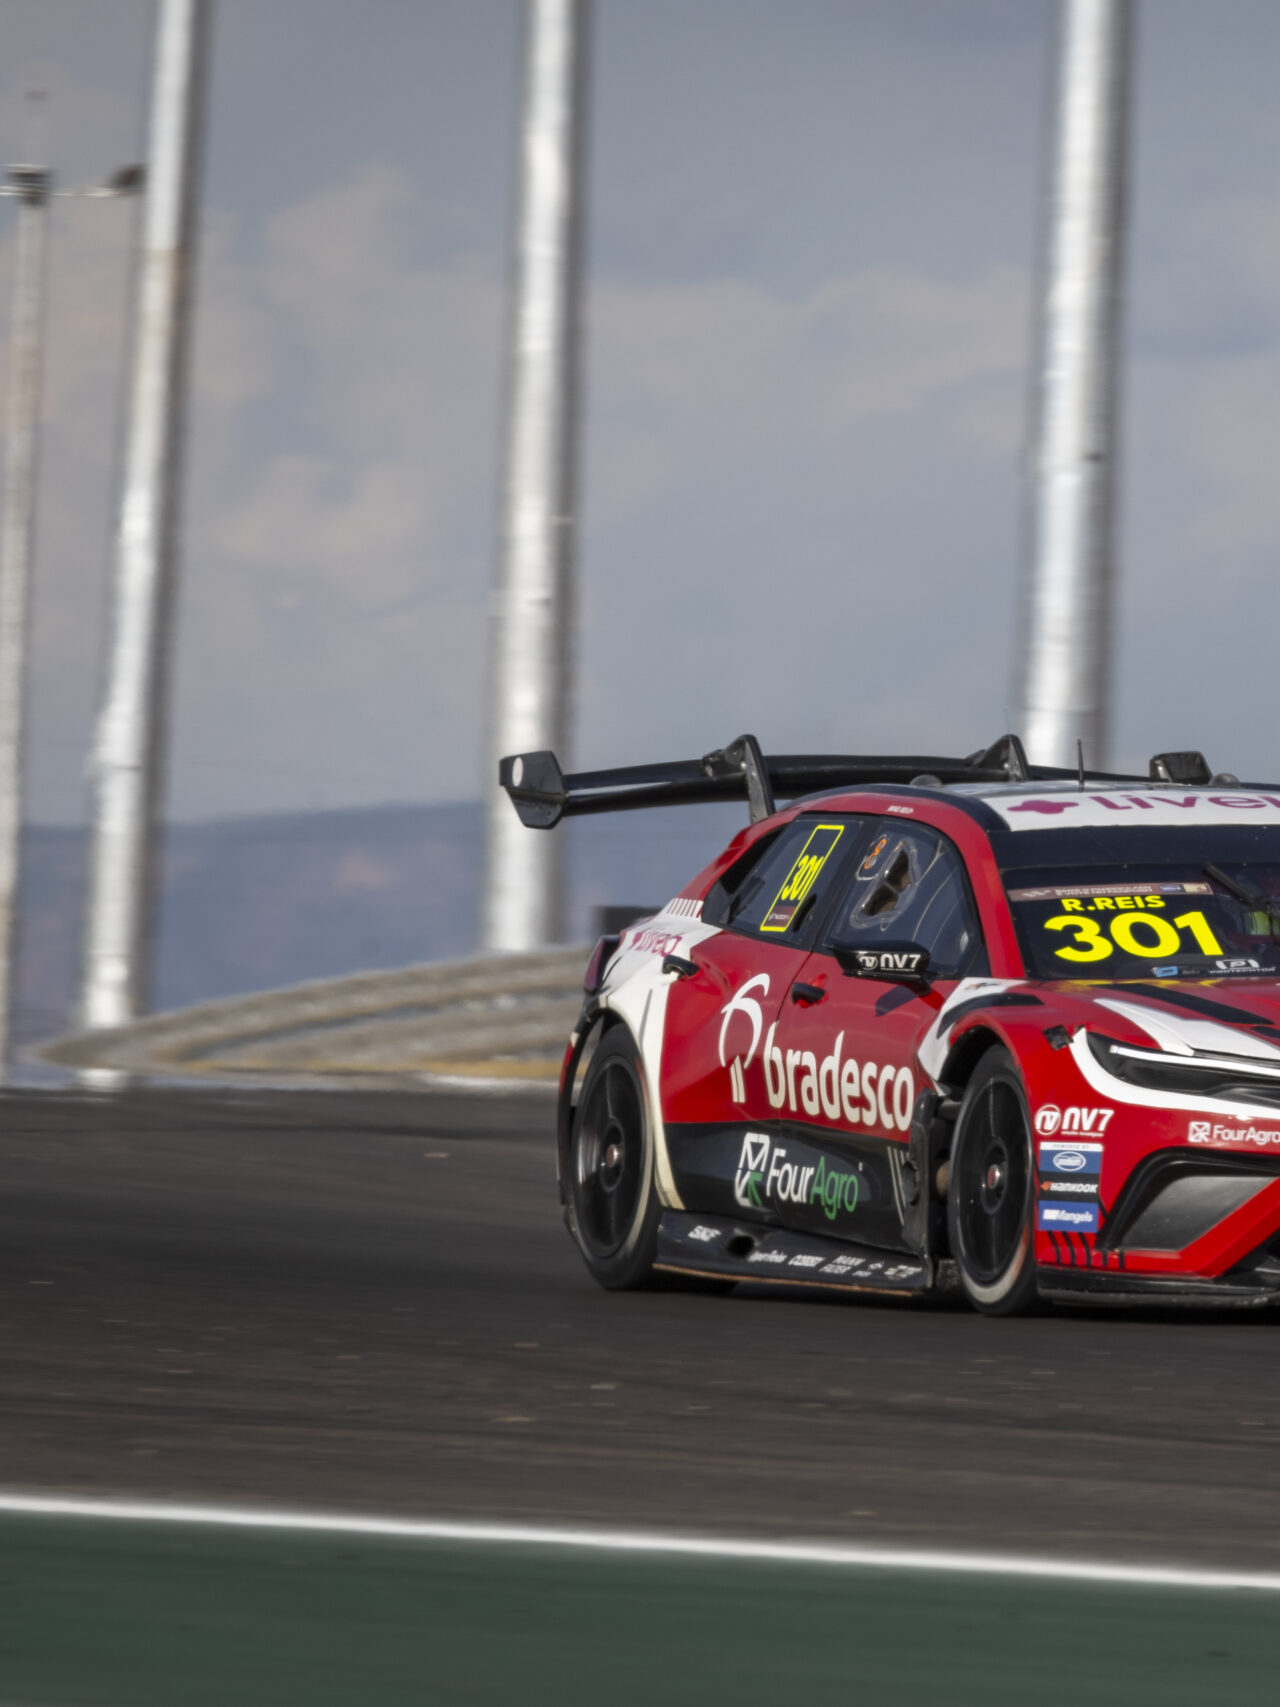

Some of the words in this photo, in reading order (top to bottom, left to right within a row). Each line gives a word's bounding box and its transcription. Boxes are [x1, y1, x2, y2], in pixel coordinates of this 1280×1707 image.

[781, 854, 824, 900] 301
[1060, 895, 1166, 912] R.REIS
[1043, 911, 1224, 963] 301
[764, 1020, 914, 1132] bradesco
[766, 1148, 858, 1220] FourAgro
